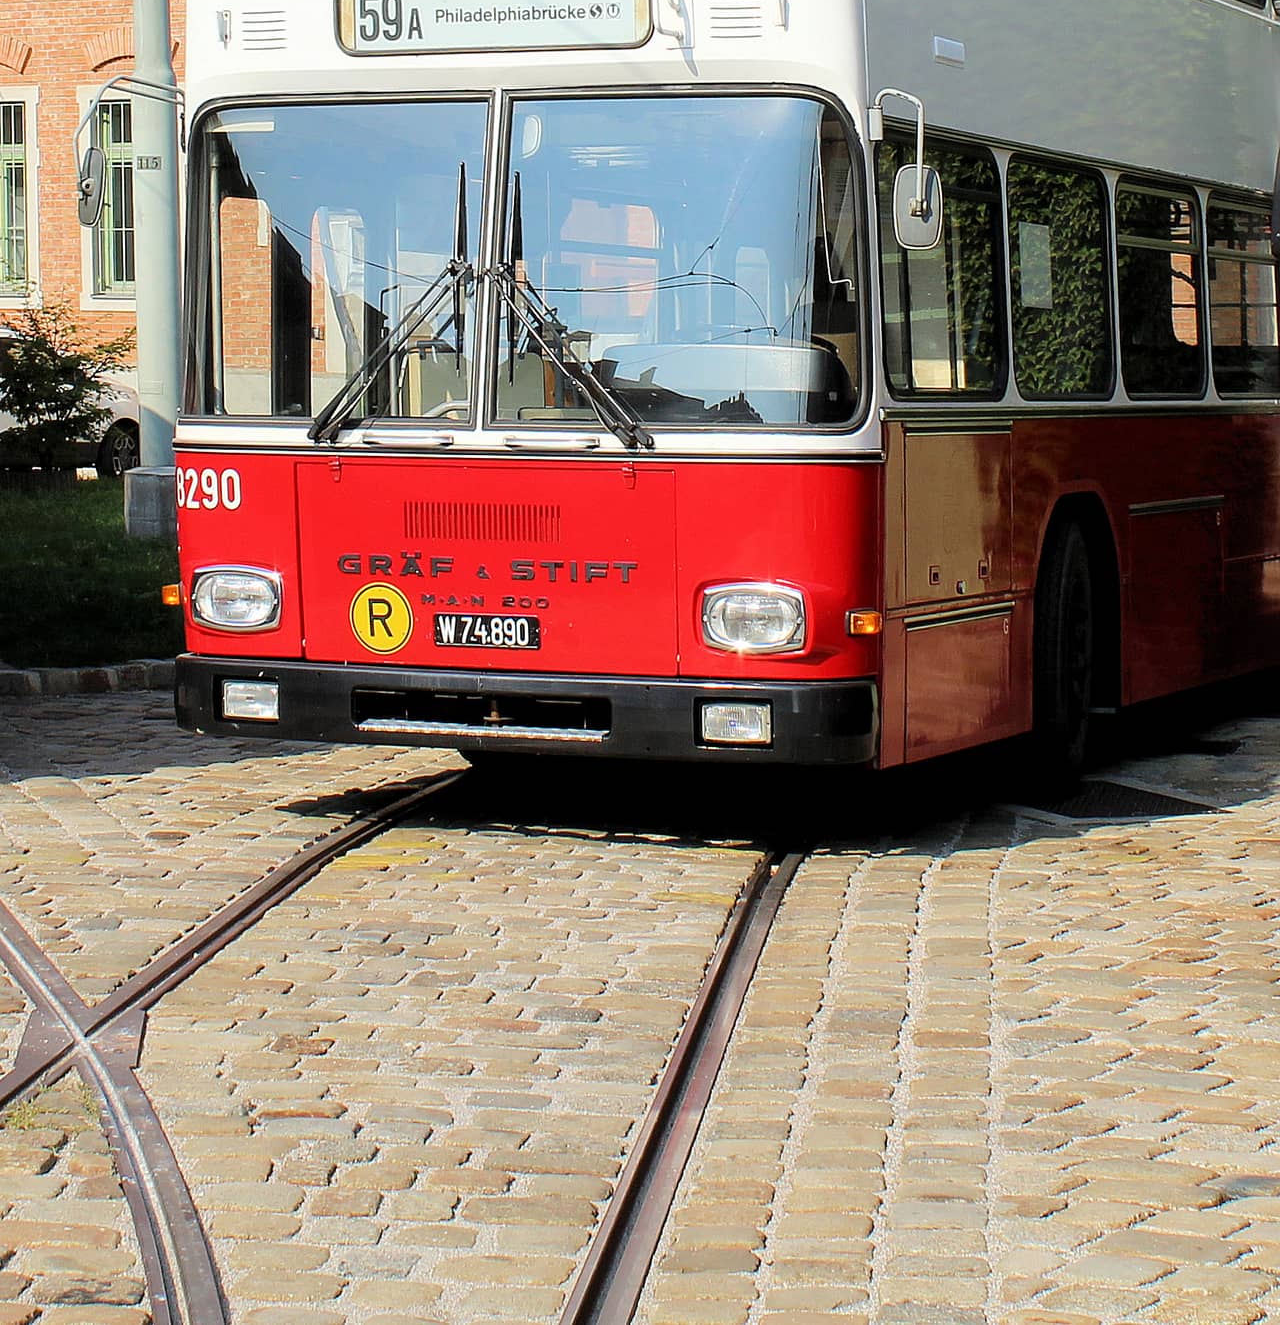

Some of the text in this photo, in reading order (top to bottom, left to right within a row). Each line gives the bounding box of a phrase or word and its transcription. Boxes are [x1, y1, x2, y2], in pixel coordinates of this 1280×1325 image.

[434, 3, 587, 25] Philadelphiabrücke
[176, 466, 242, 510] 8290
[337, 552, 454, 577] GRÄF
[511, 559, 639, 583] STIFT
[368, 598, 394, 638] R
[438, 615, 457, 644] W
